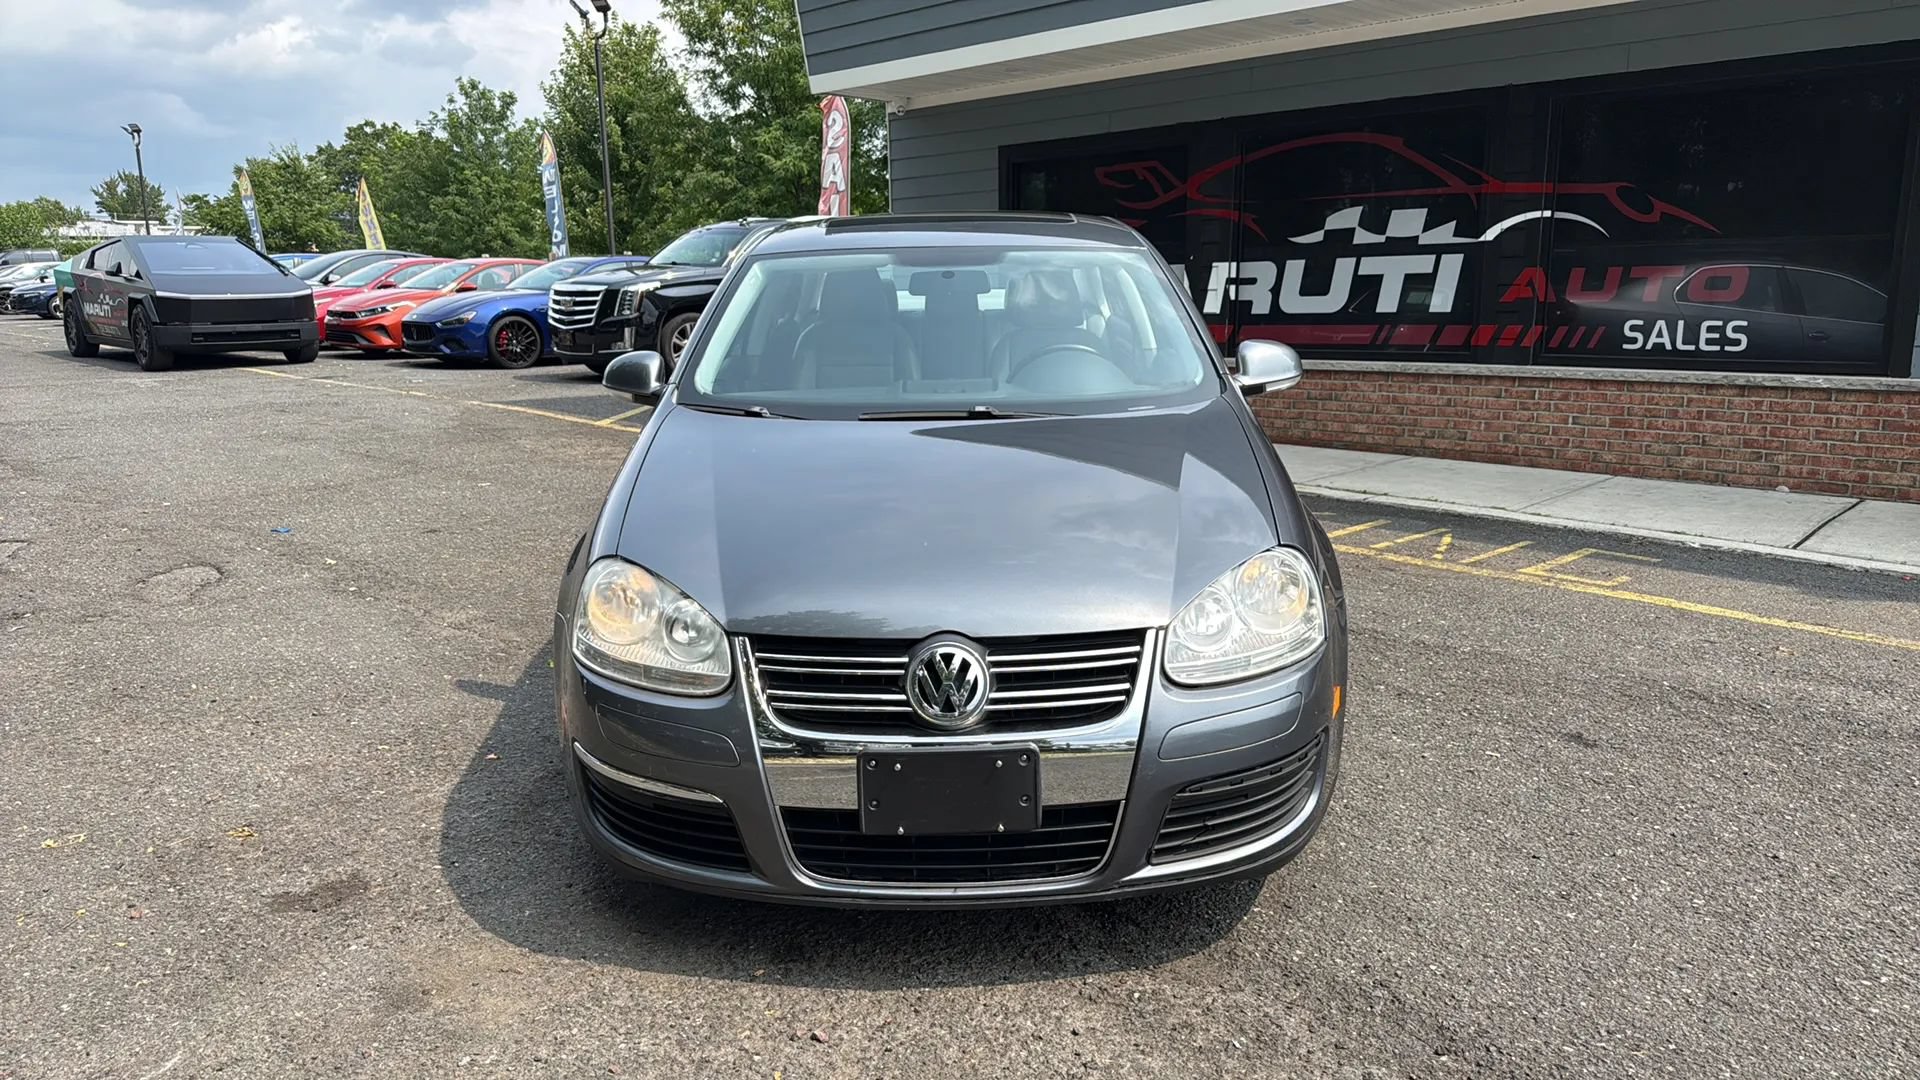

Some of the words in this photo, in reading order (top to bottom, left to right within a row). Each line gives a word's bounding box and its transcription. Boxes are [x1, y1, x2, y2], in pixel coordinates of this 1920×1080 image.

[1169, 253, 1465, 315] RUTI
[1499, 265, 1750, 304] AUTO
[1622, 319, 1749, 352] SALES
[912, 645, 985, 720] VW
